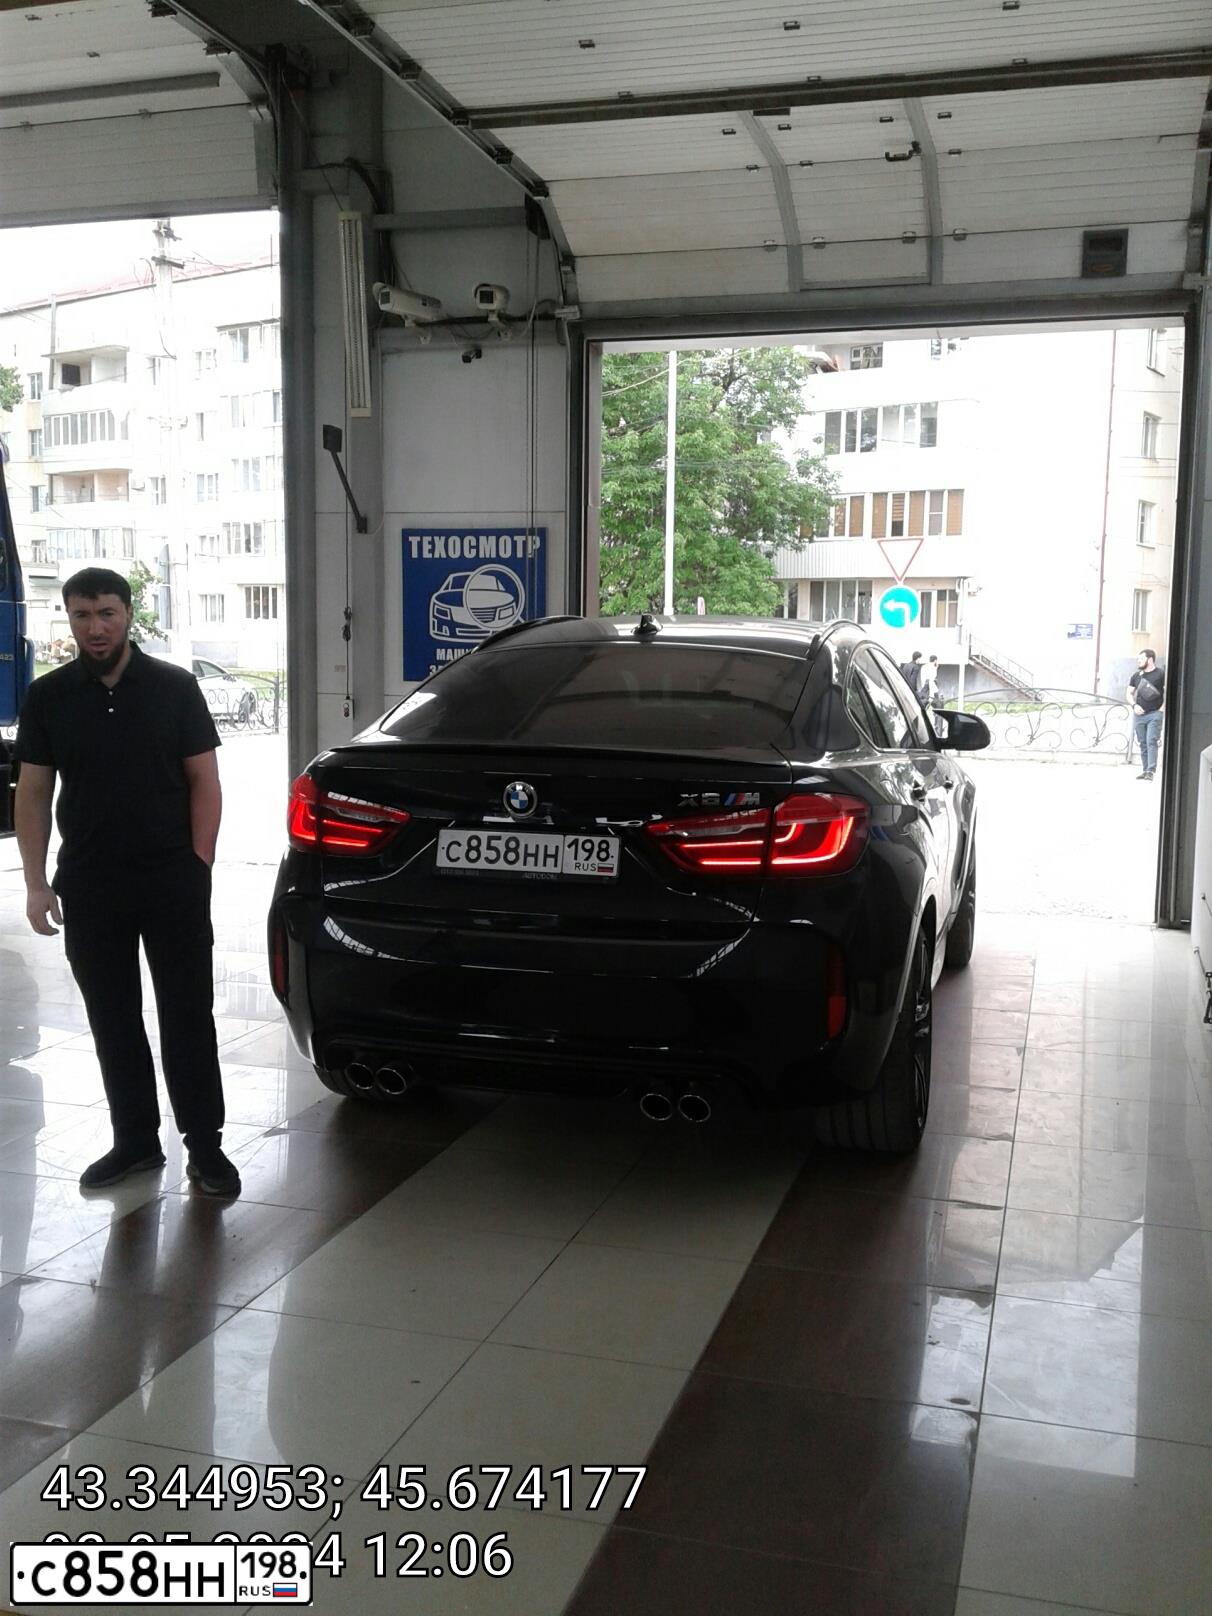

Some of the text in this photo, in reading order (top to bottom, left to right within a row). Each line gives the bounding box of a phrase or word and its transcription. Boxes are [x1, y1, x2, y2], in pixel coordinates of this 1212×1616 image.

[408, 535, 541, 559] ТЕХОСМОТР
[567, 838, 609, 862] 198
[574, 862, 596, 872] RUS
